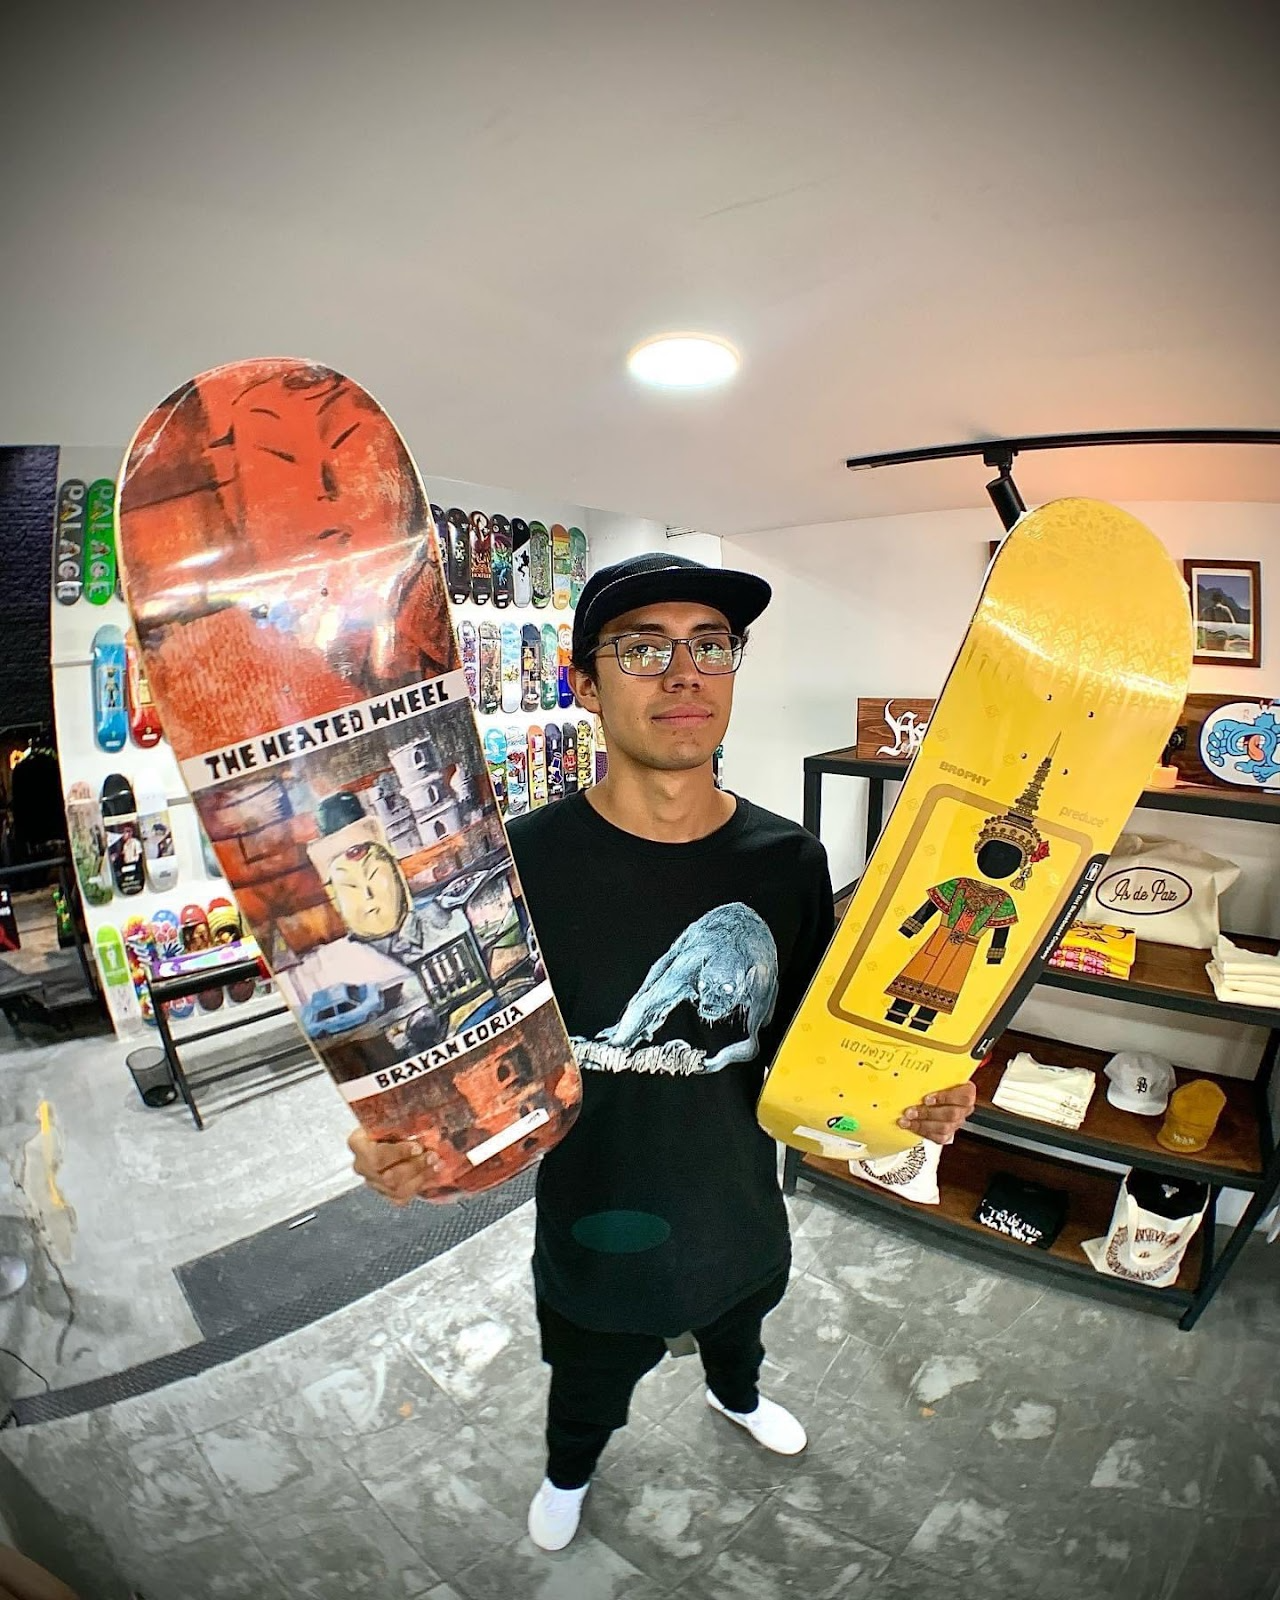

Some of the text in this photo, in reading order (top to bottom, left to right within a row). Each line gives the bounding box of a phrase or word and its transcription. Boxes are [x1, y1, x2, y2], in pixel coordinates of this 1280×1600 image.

[57, 484, 83, 598] PALACE
[89, 484, 113, 598] PALACE
[205, 680, 449, 779] THE HEATED WHEEL
[938, 761, 991, 787] BROPHY
[1109, 878, 1131, 903] As
[1133, 885, 1149, 901] de
[374, 1005, 524, 1089] BRAYAN CORIA
